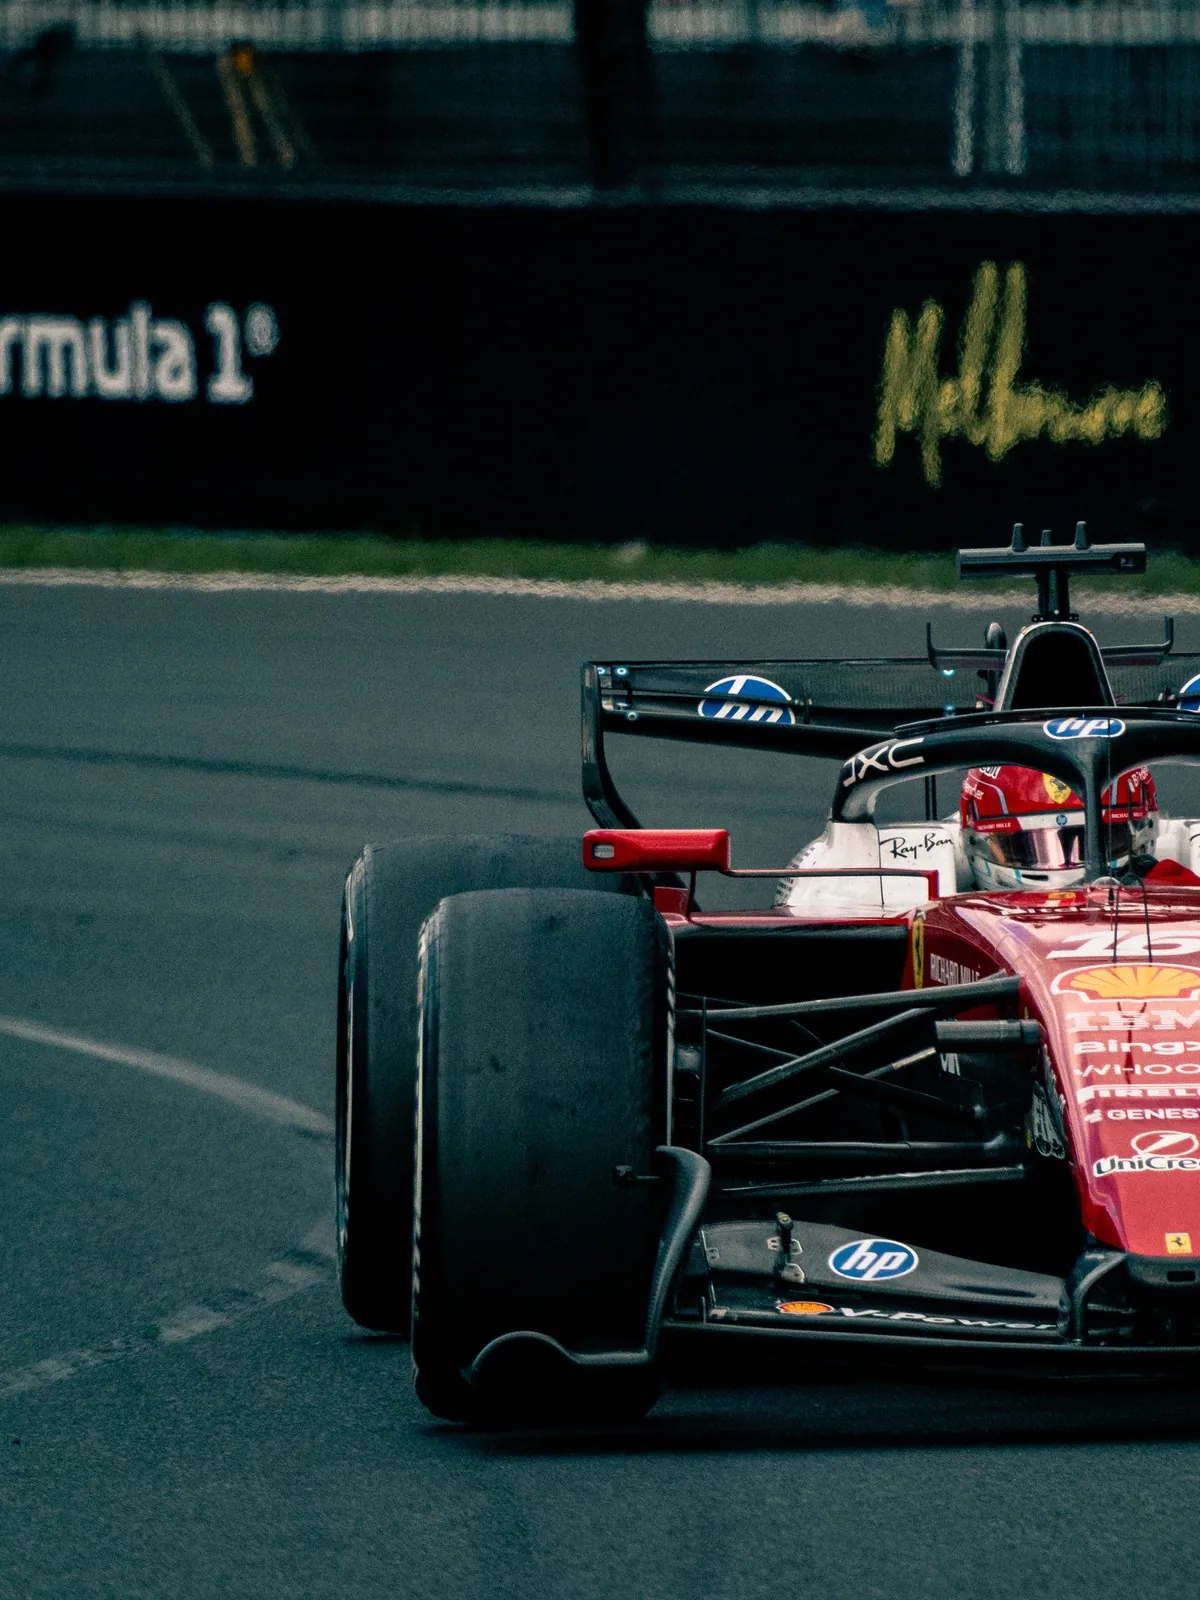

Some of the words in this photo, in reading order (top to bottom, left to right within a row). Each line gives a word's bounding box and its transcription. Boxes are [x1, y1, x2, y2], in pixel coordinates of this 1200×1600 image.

[1051, 716, 1119, 738] hp
[879, 832, 955, 860] Ray-Ban
[838, 1239, 910, 1280] hp
[840, 1306, 1058, 1330] V-Power
